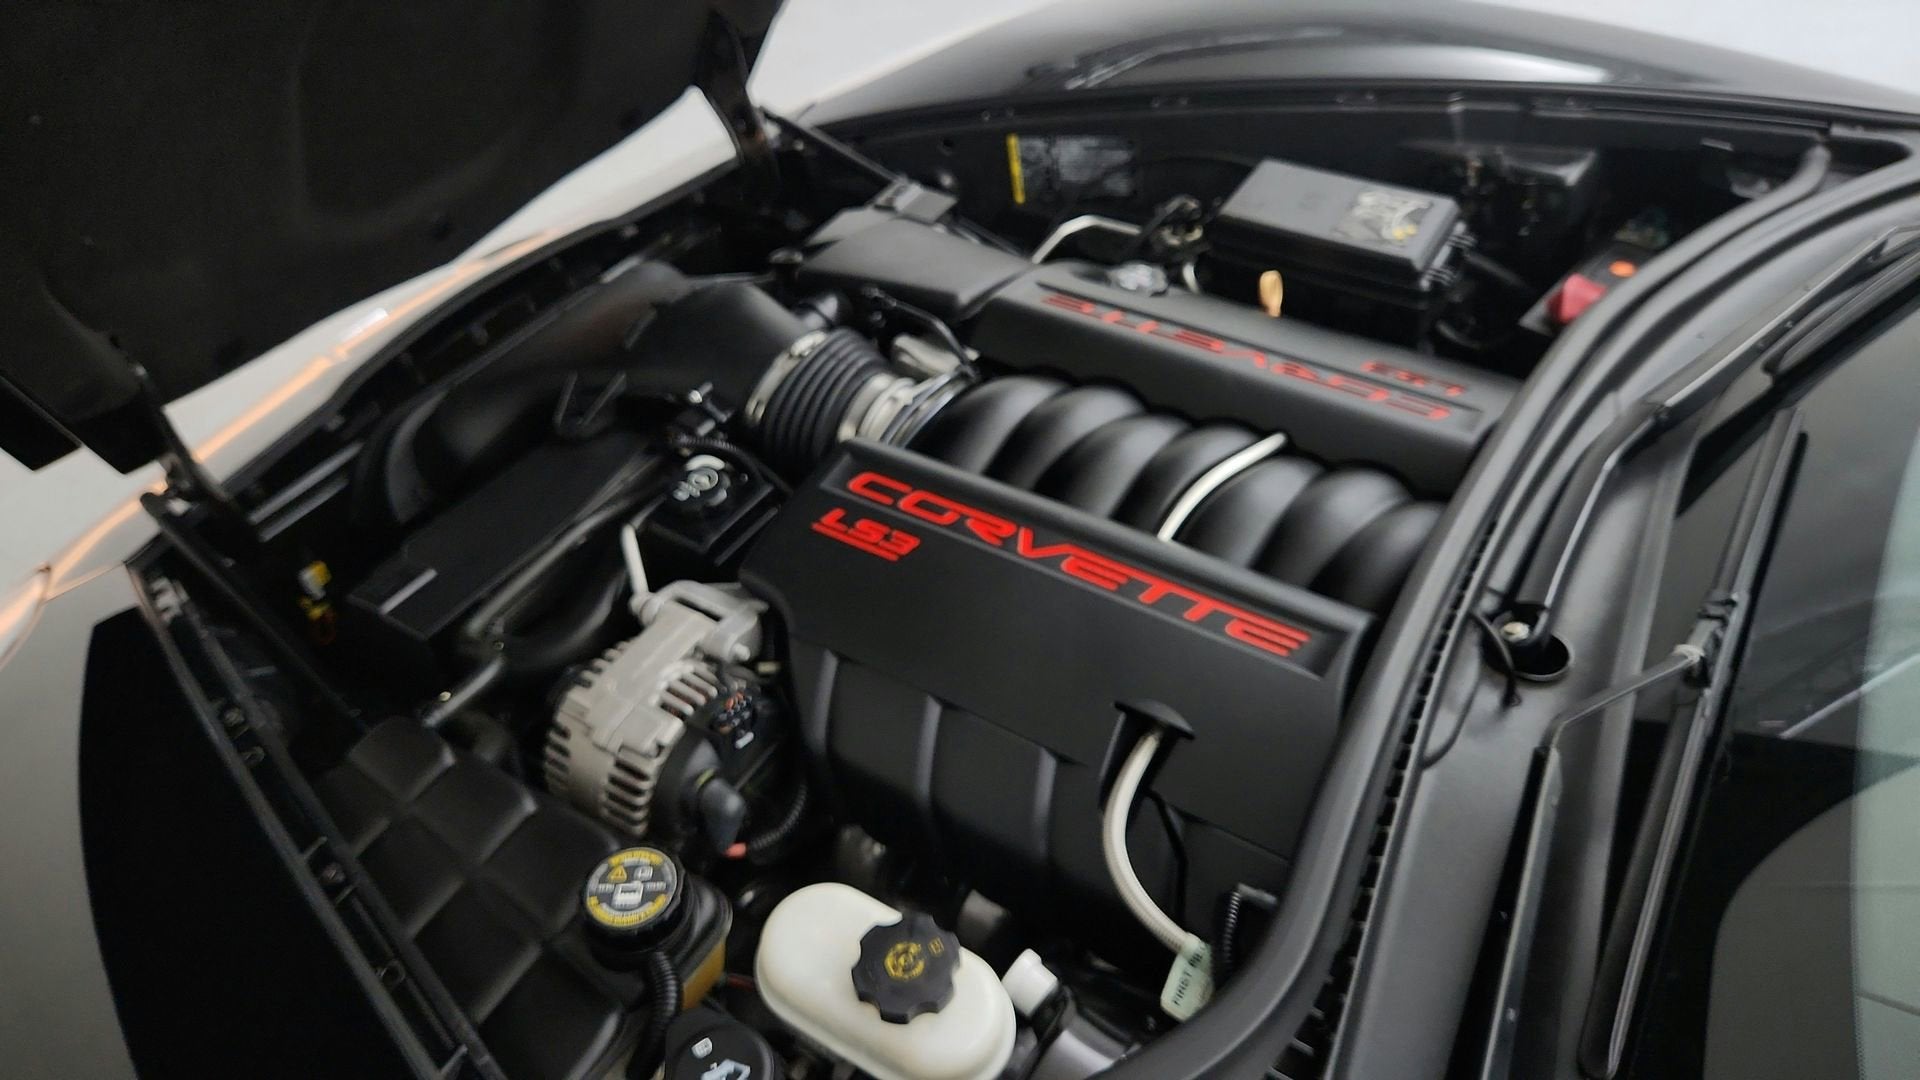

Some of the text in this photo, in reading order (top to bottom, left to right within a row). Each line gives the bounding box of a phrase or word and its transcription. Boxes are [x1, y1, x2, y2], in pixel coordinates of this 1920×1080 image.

[1043, 294, 1452, 421] CORVETTE
[812, 507, 921, 562] LS3
[847, 471, 1311, 657] CORVETTE
